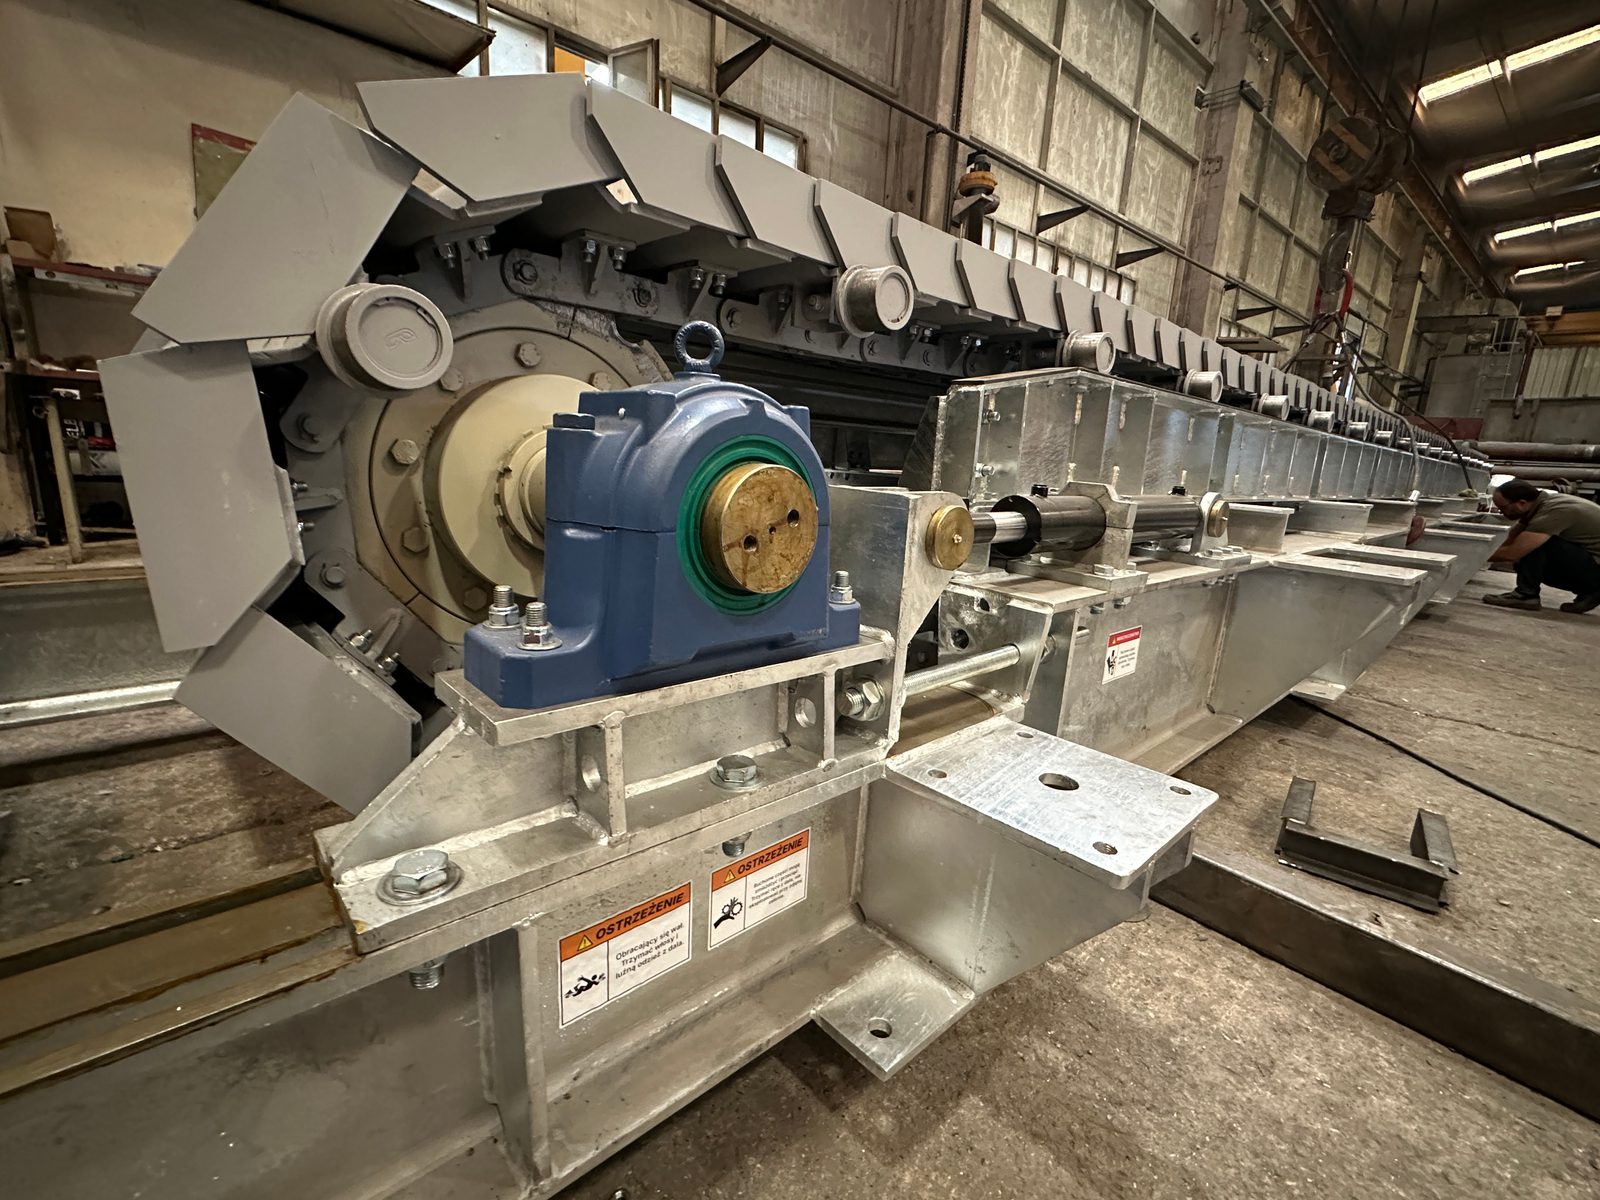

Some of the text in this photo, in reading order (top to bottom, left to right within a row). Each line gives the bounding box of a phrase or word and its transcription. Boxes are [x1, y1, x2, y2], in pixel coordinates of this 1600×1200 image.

[737, 837, 804, 874] OSTRZEŻENIE
[596, 892, 684, 940] OSTRZEŻENIE
[616, 936, 658, 960] Obracający
[621, 948, 653, 966] Trzymać
